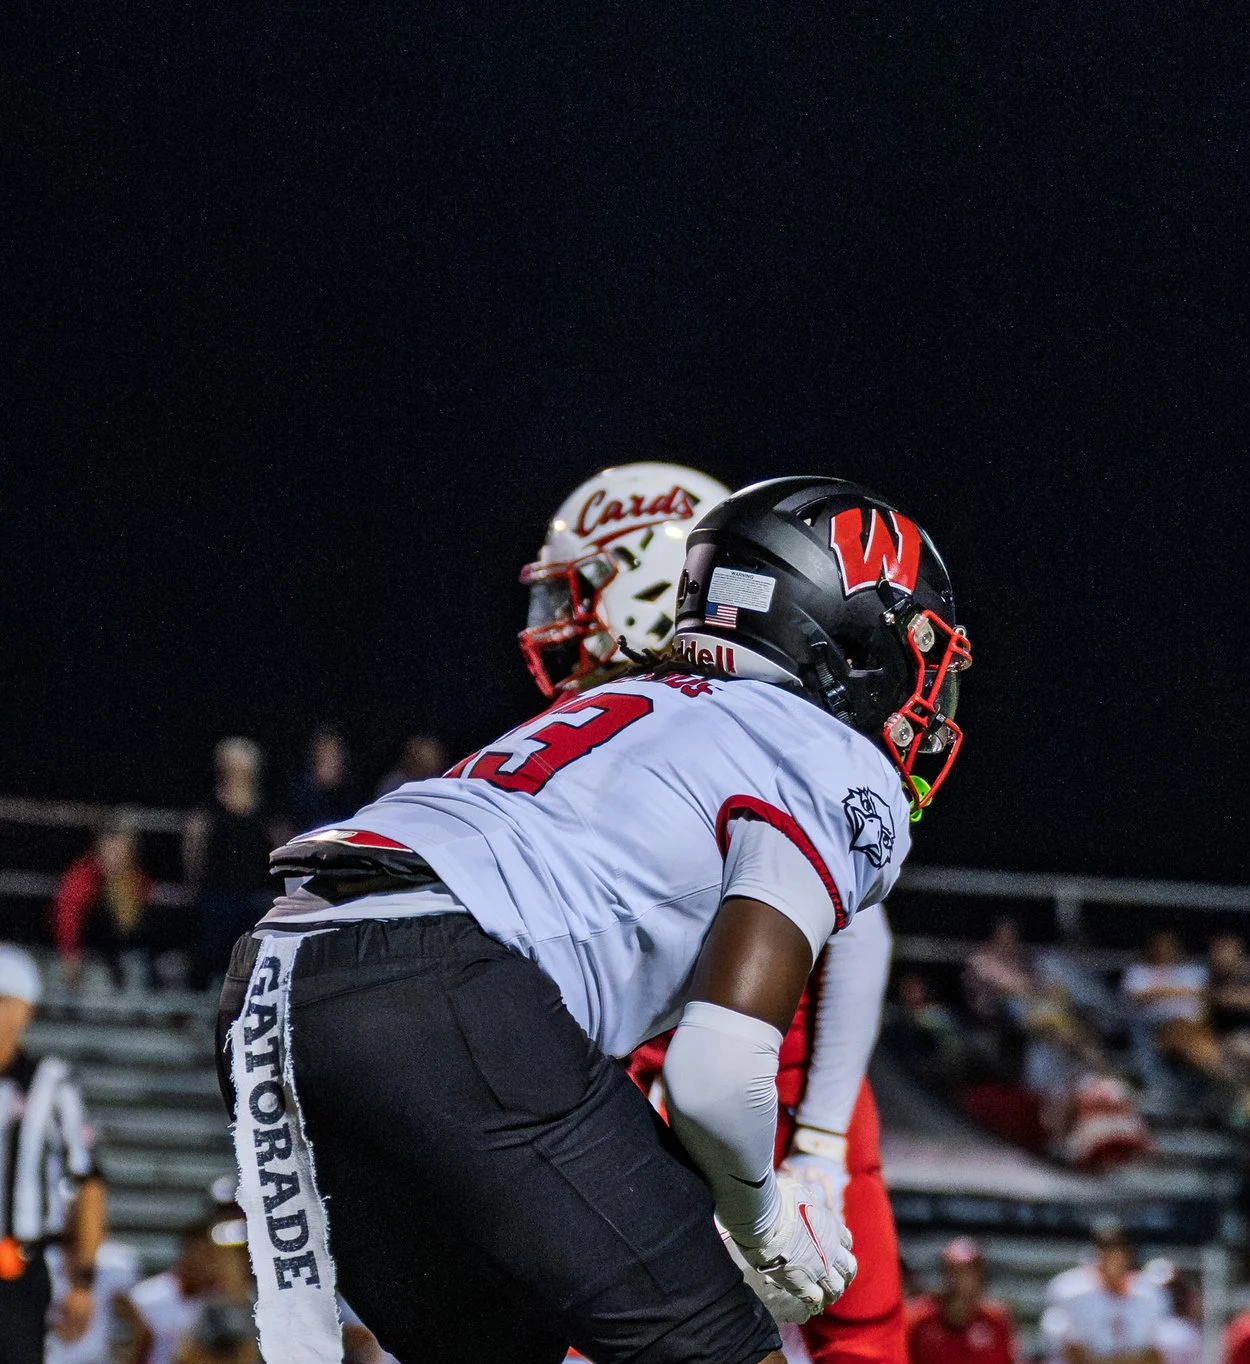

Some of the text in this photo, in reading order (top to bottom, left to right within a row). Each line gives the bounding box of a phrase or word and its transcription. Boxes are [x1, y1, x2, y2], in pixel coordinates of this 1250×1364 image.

[573, 484, 694, 538] Cards
[829, 506, 923, 600] W
[243, 955, 320, 1291] GATORADE
